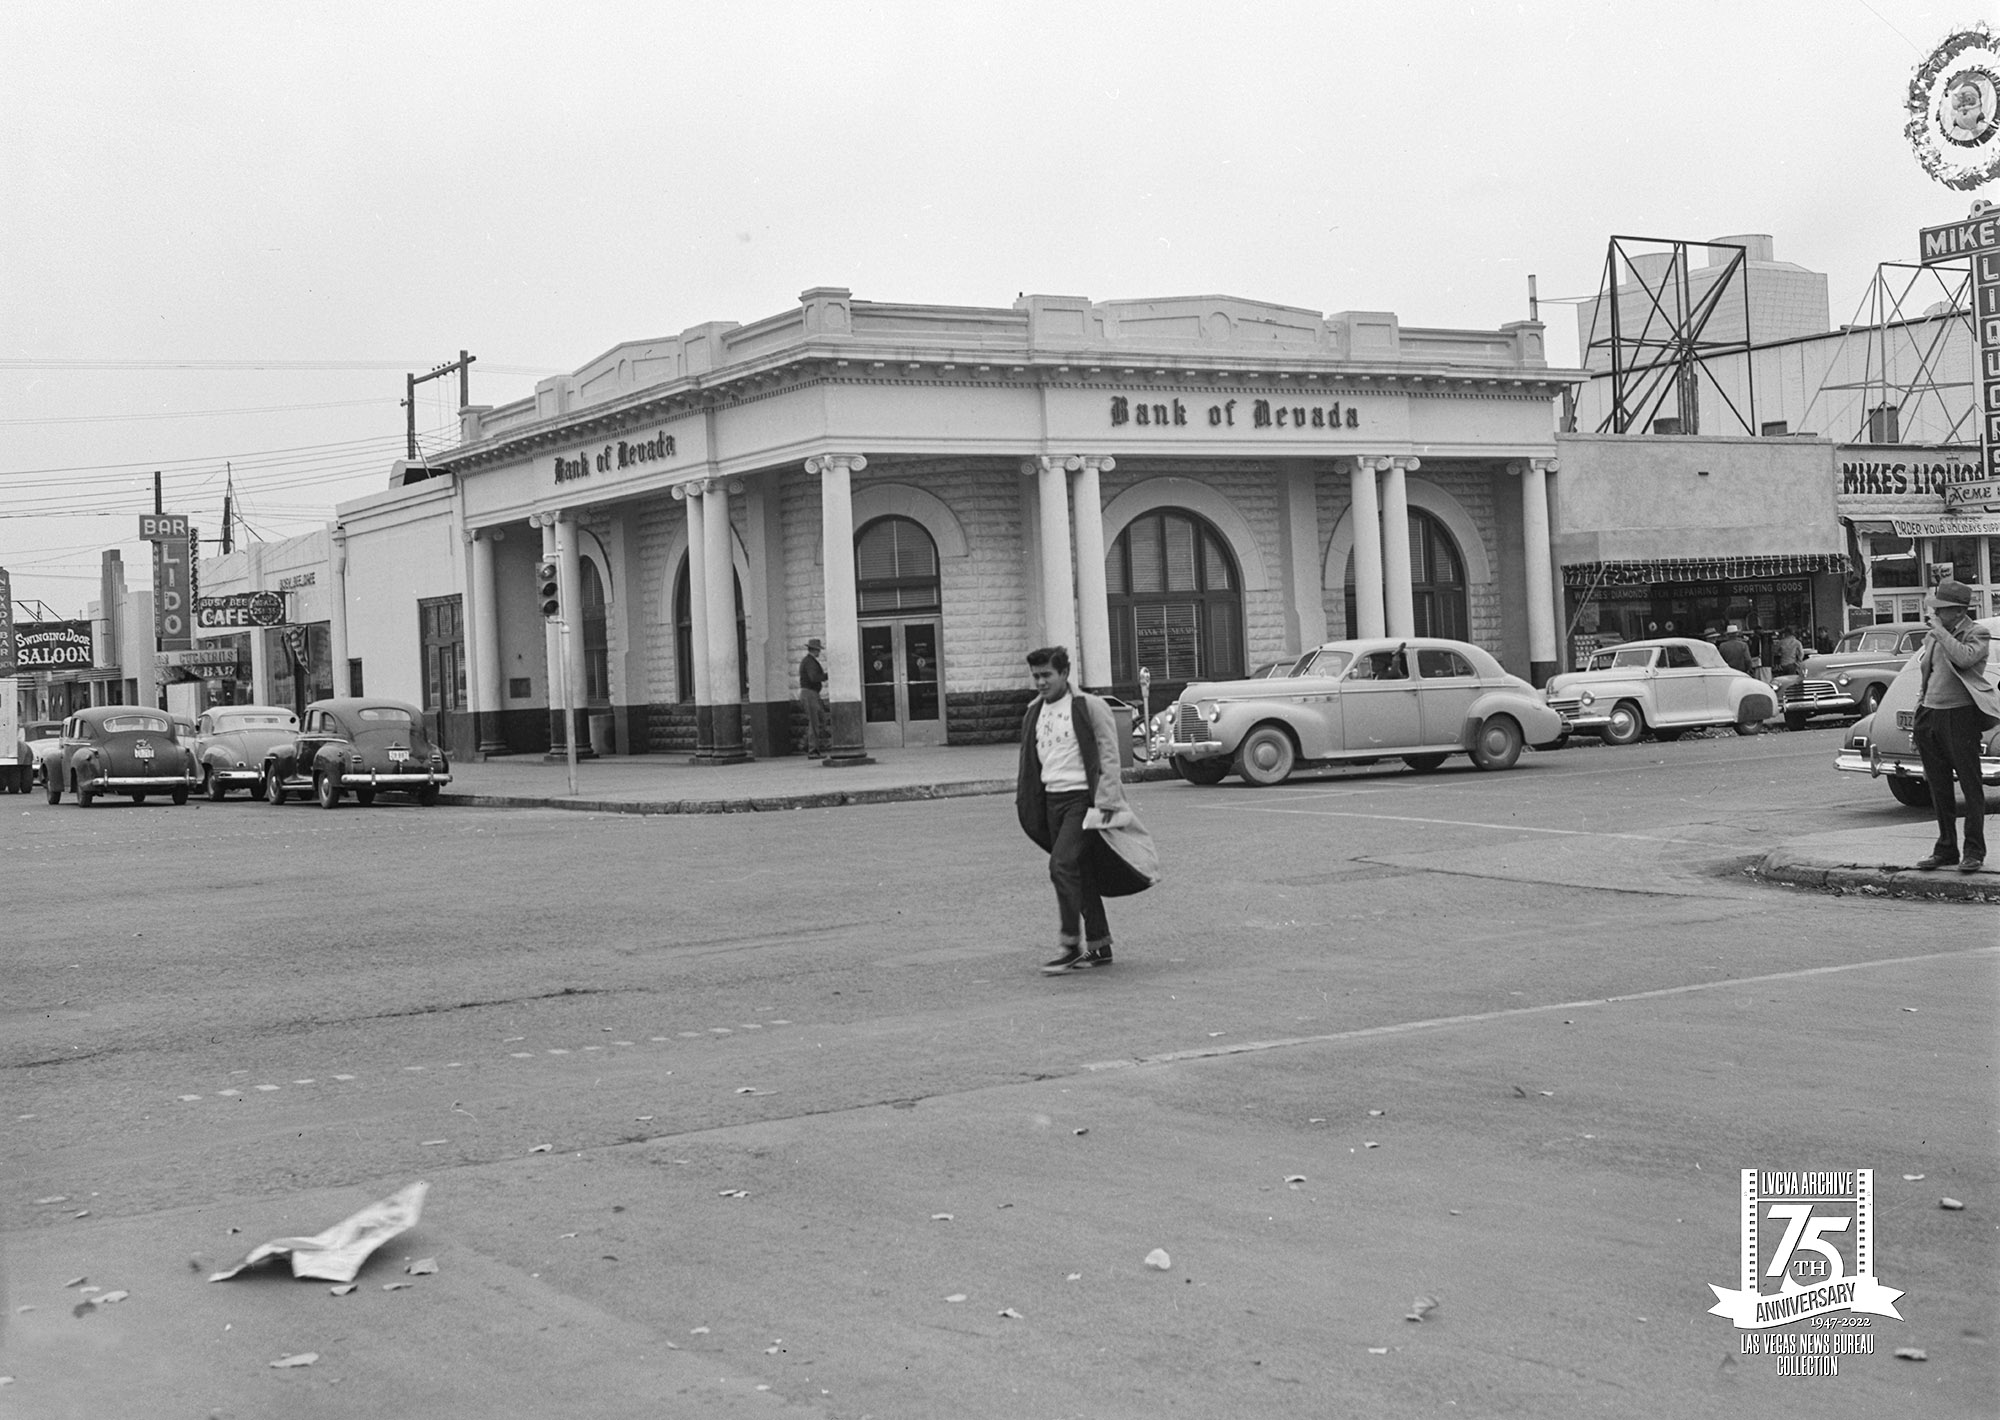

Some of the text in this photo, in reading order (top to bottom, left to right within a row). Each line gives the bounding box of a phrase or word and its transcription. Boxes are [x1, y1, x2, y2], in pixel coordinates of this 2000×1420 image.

[1111, 396, 1359, 429] Bank of Nevada
[554, 430, 676, 485] Bank of Nevada
[1843, 462, 1908, 495] MIKES
[1949, 486, 1991, 504] ACME
[144, 519, 186, 535] BAR
[1895, 521, 1921, 535] ORDER
[1924, 524, 1946, 534] YOUR
[163, 544, 182, 634] LIDO
[1733, 582, 1804, 594] SPORTING GOODS
[201, 598, 248, 606] BUSY BEE
[202, 608, 249, 625] CAFE
[0, 632, 9, 656] BAR
[15, 628, 91, 648] SWINGING DOOR
[17, 646, 91, 666] SALOON
[203, 665, 235, 677] BAR
